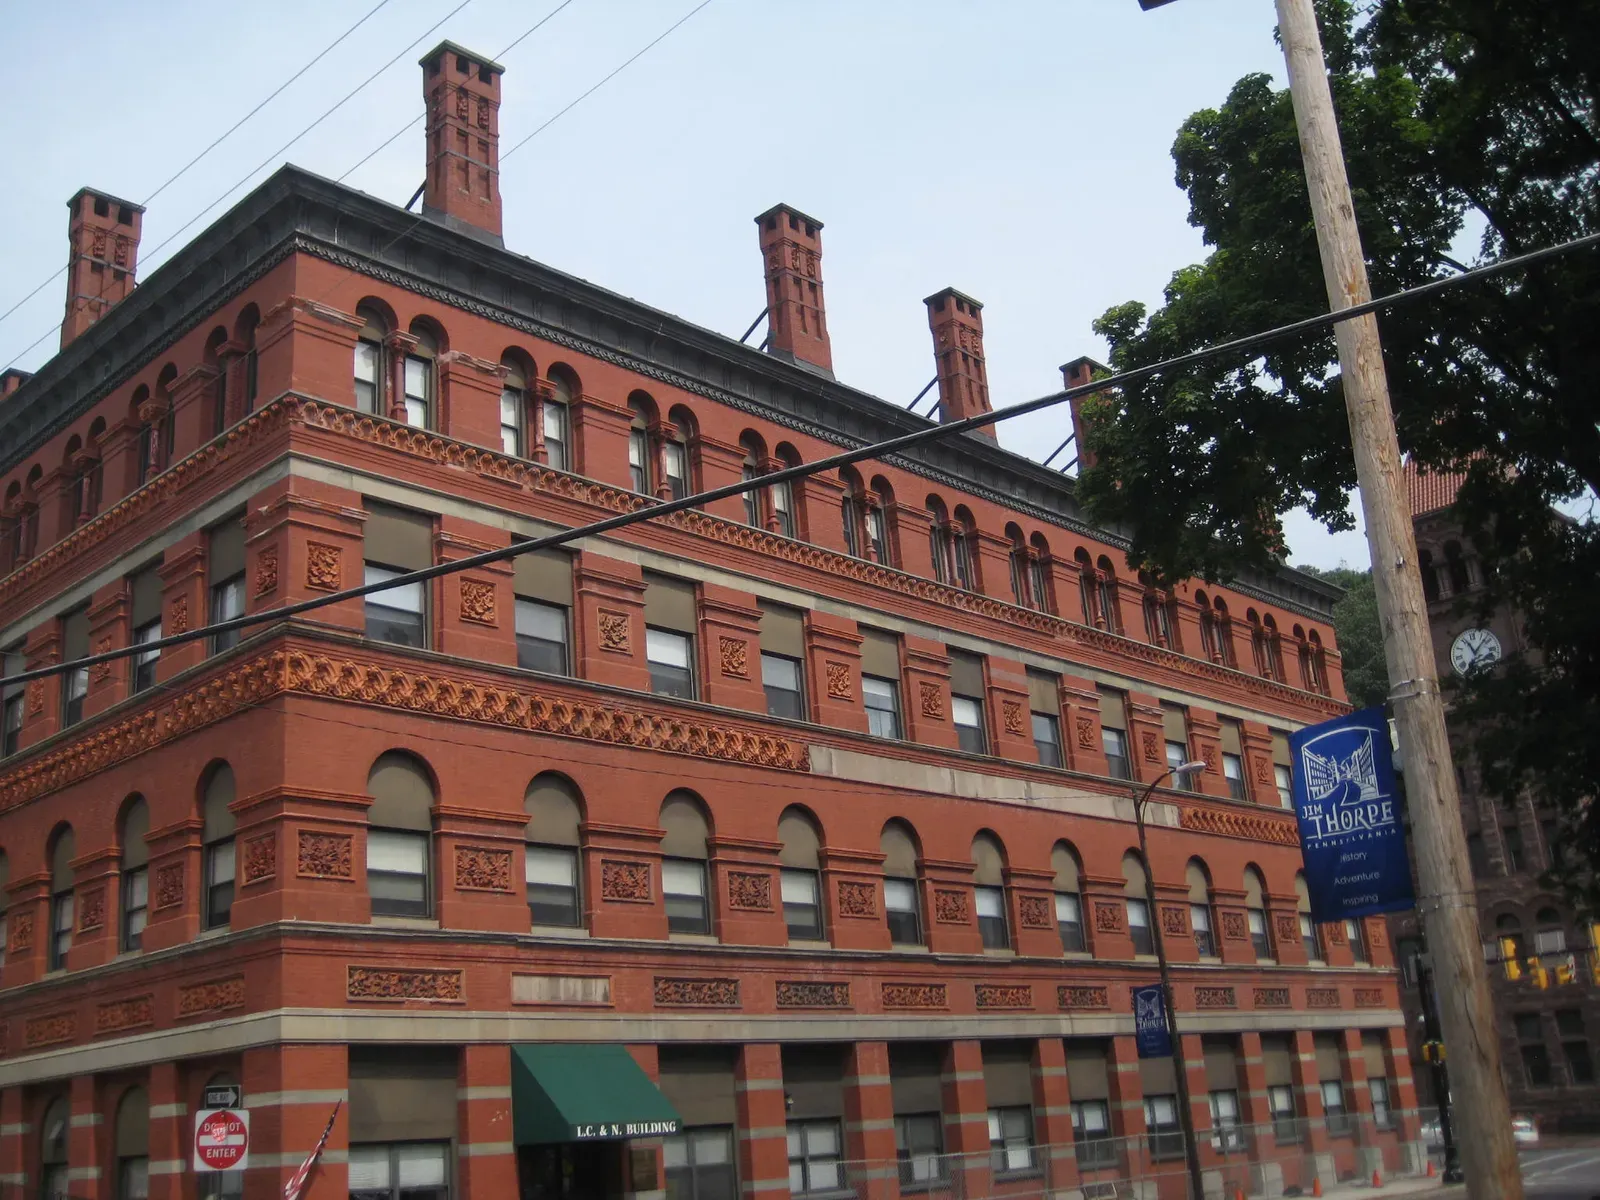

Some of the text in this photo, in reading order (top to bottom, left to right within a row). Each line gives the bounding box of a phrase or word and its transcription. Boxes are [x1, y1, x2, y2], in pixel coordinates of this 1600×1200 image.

[1302, 803, 1323, 819] JIM
[1308, 801, 1394, 840] THORPE
[1307, 828, 1396, 849] PENNSYLVANIA
[1340, 852, 1368, 863] History
[1334, 872, 1380, 885] Adventure
[577, 1121, 677, 1137] L.C. & N. BUILDING
[207, 1148, 236, 1158] ENTER
